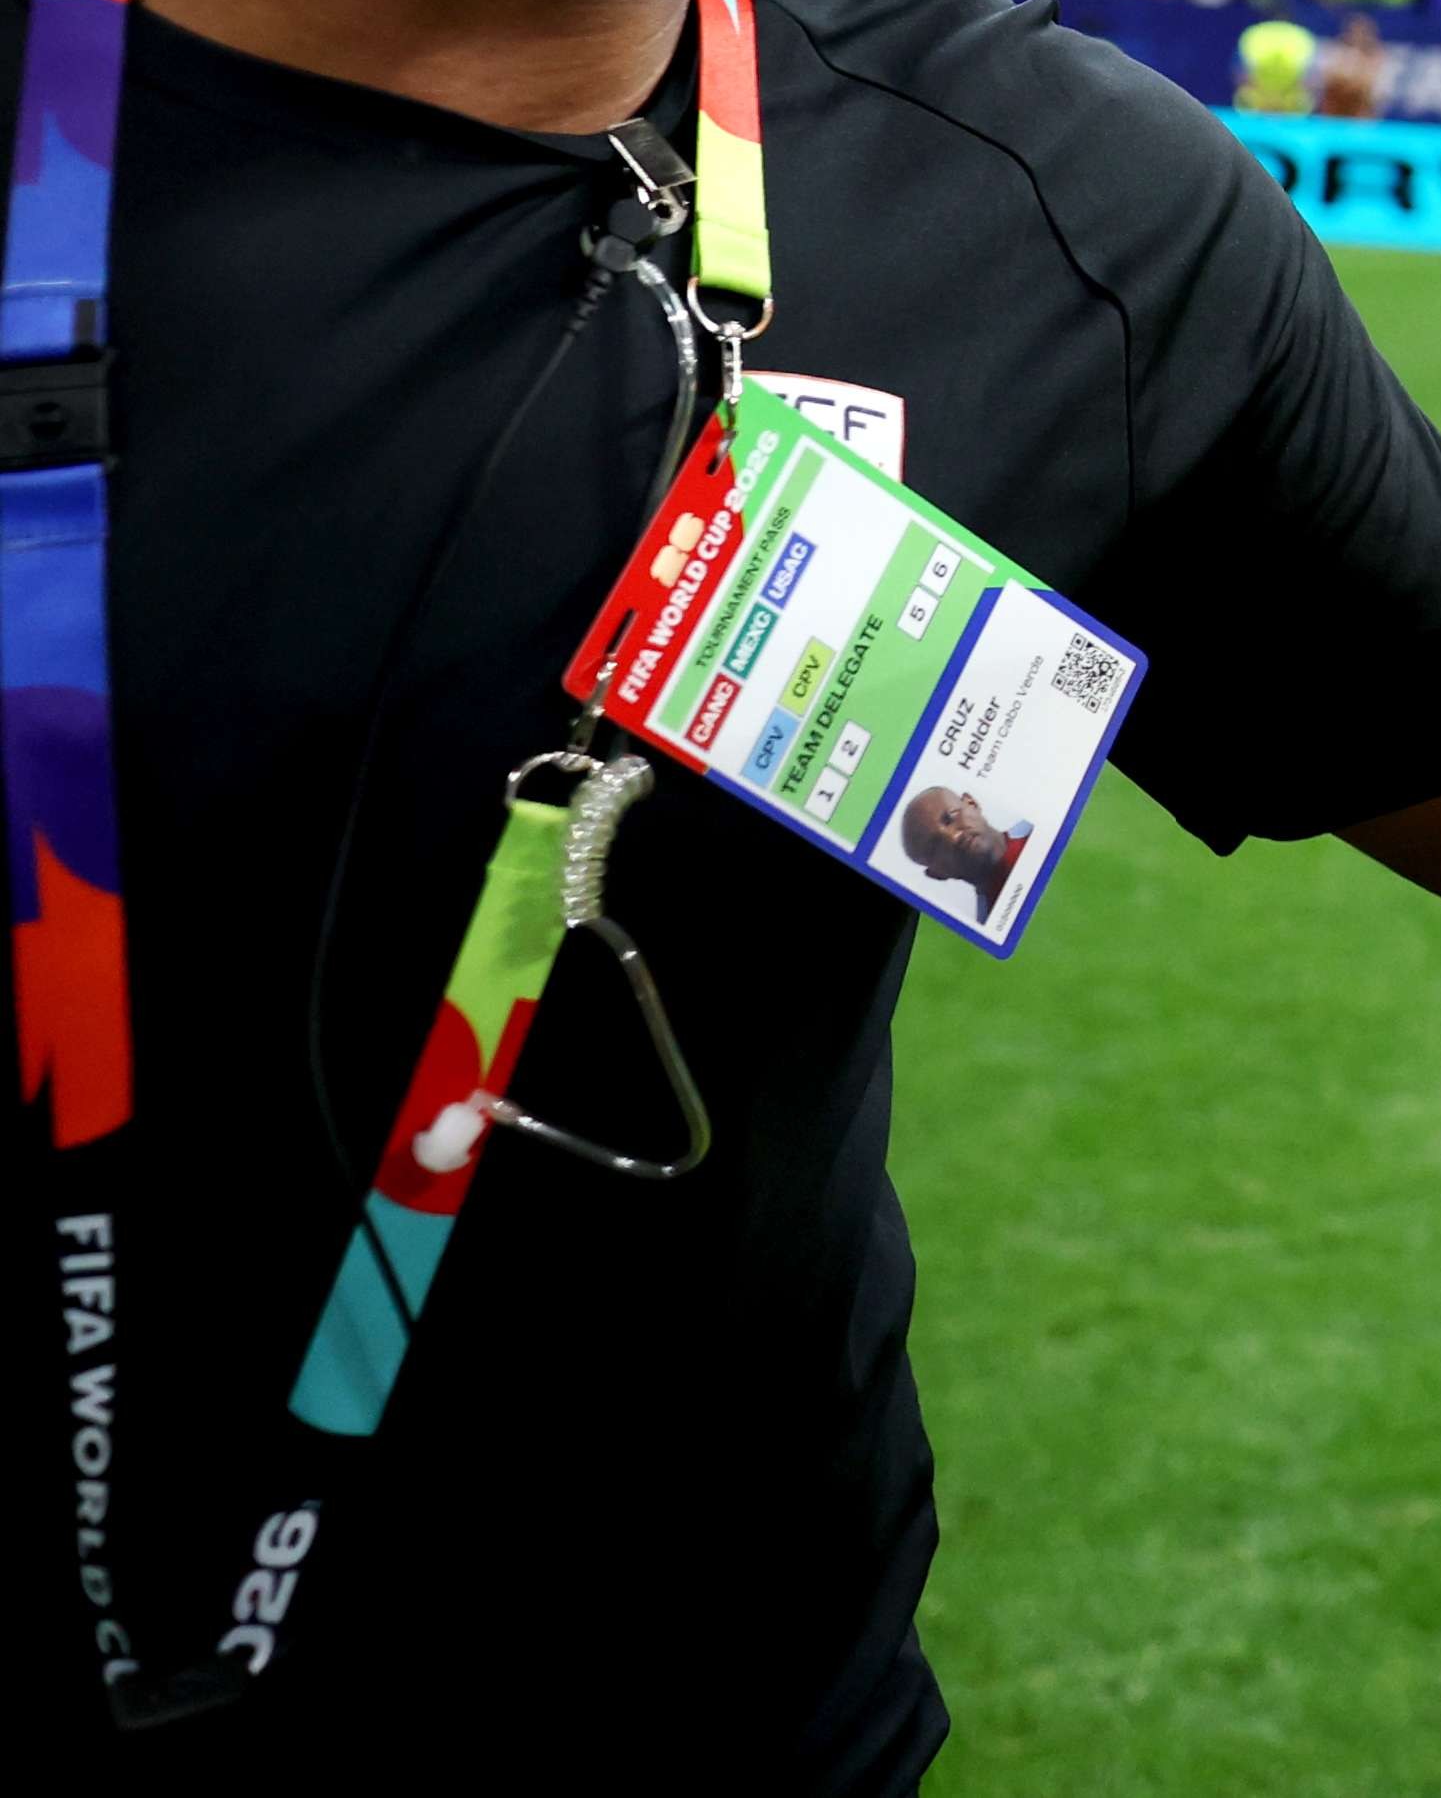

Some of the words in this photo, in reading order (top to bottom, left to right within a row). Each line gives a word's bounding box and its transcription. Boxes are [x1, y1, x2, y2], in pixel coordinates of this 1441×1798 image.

[617, 644, 664, 704] FIFA
[648, 558, 710, 646] WORLD
[696, 509, 736, 562] CUP
[722, 428, 780, 513] 2026
[695, 554, 765, 669] TOURNAMENT
[759, 506, 791, 552] PASS
[753, 724, 785, 770] CPV
[791, 654, 822, 699] CPV
[779, 729, 824, 794] TEAM
[815, 613, 884, 728] DELEGATE
[817, 786, 834, 802] 1
[841, 738, 859, 757] 2
[908, 604, 926, 622] 5
[930, 561, 948, 579] 6
[936, 697, 975, 757] CRUZ
[957, 695, 1003, 770] Helder
[976, 739, 1004, 779] Team
[997, 698, 1023, 738] Cabo
[1016, 654, 1044, 697] Verde
[56, 1213, 116, 1354] FIFA
[69, 1364, 116, 1607] WORLD
